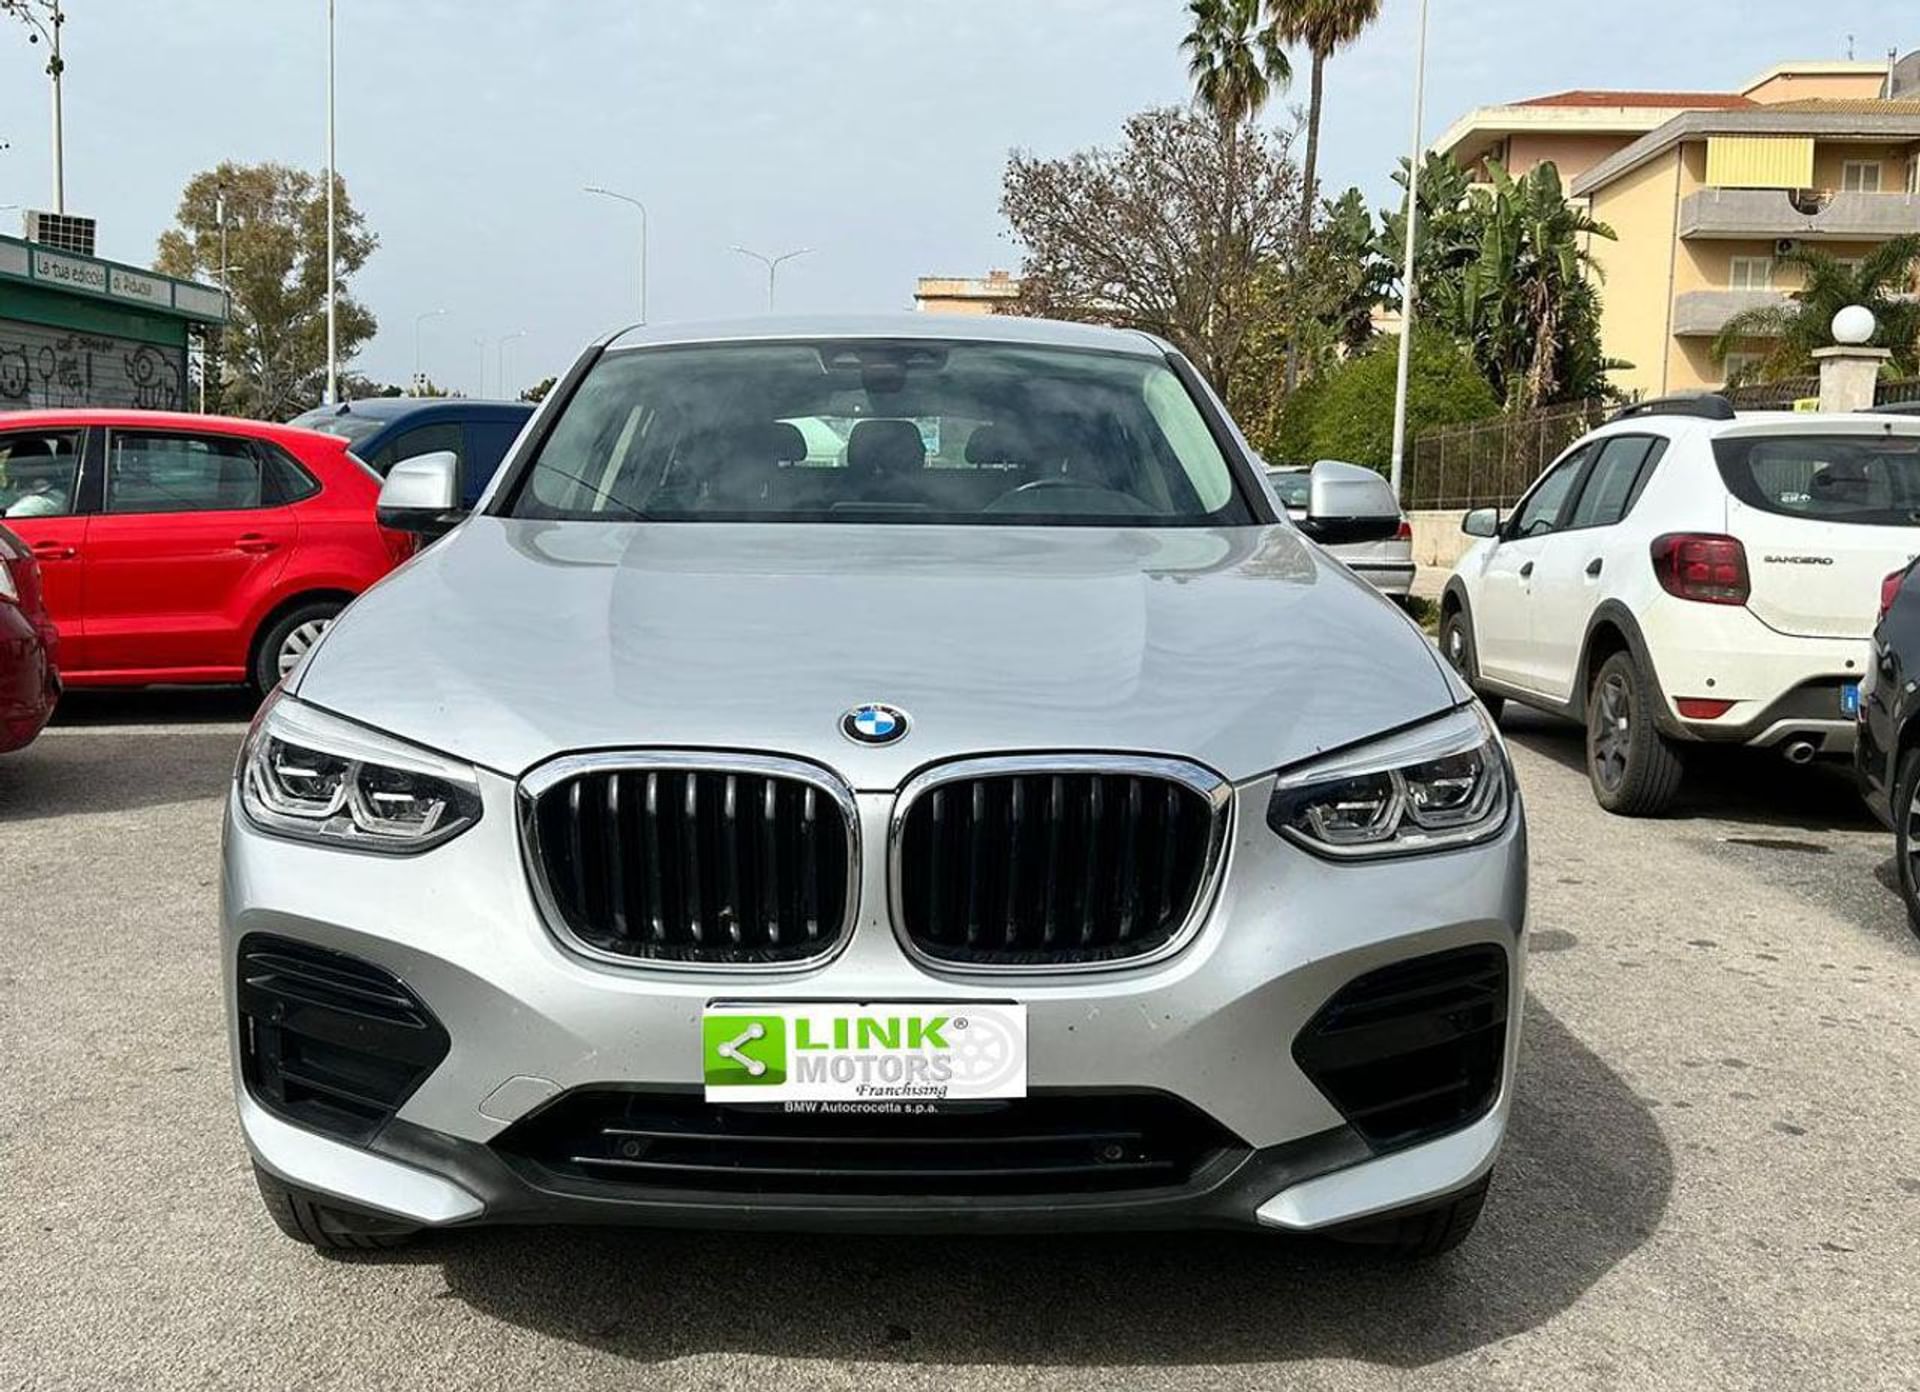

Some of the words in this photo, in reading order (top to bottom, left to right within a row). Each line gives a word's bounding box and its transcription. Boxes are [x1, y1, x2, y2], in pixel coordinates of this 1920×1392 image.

[37, 254, 49, 275] La
[52, 264, 70, 280] tua
[1763, 555, 1834, 566] SANDERO
[795, 1017, 950, 1050] LINK
[795, 1054, 953, 1084] MOTORS
[856, 1081, 949, 1099] Franchising
[784, 1101, 817, 1113] BMW
[820, 1101, 902, 1114] Autocrocetta
[904, 1103, 939, 1115] s.p.a.
